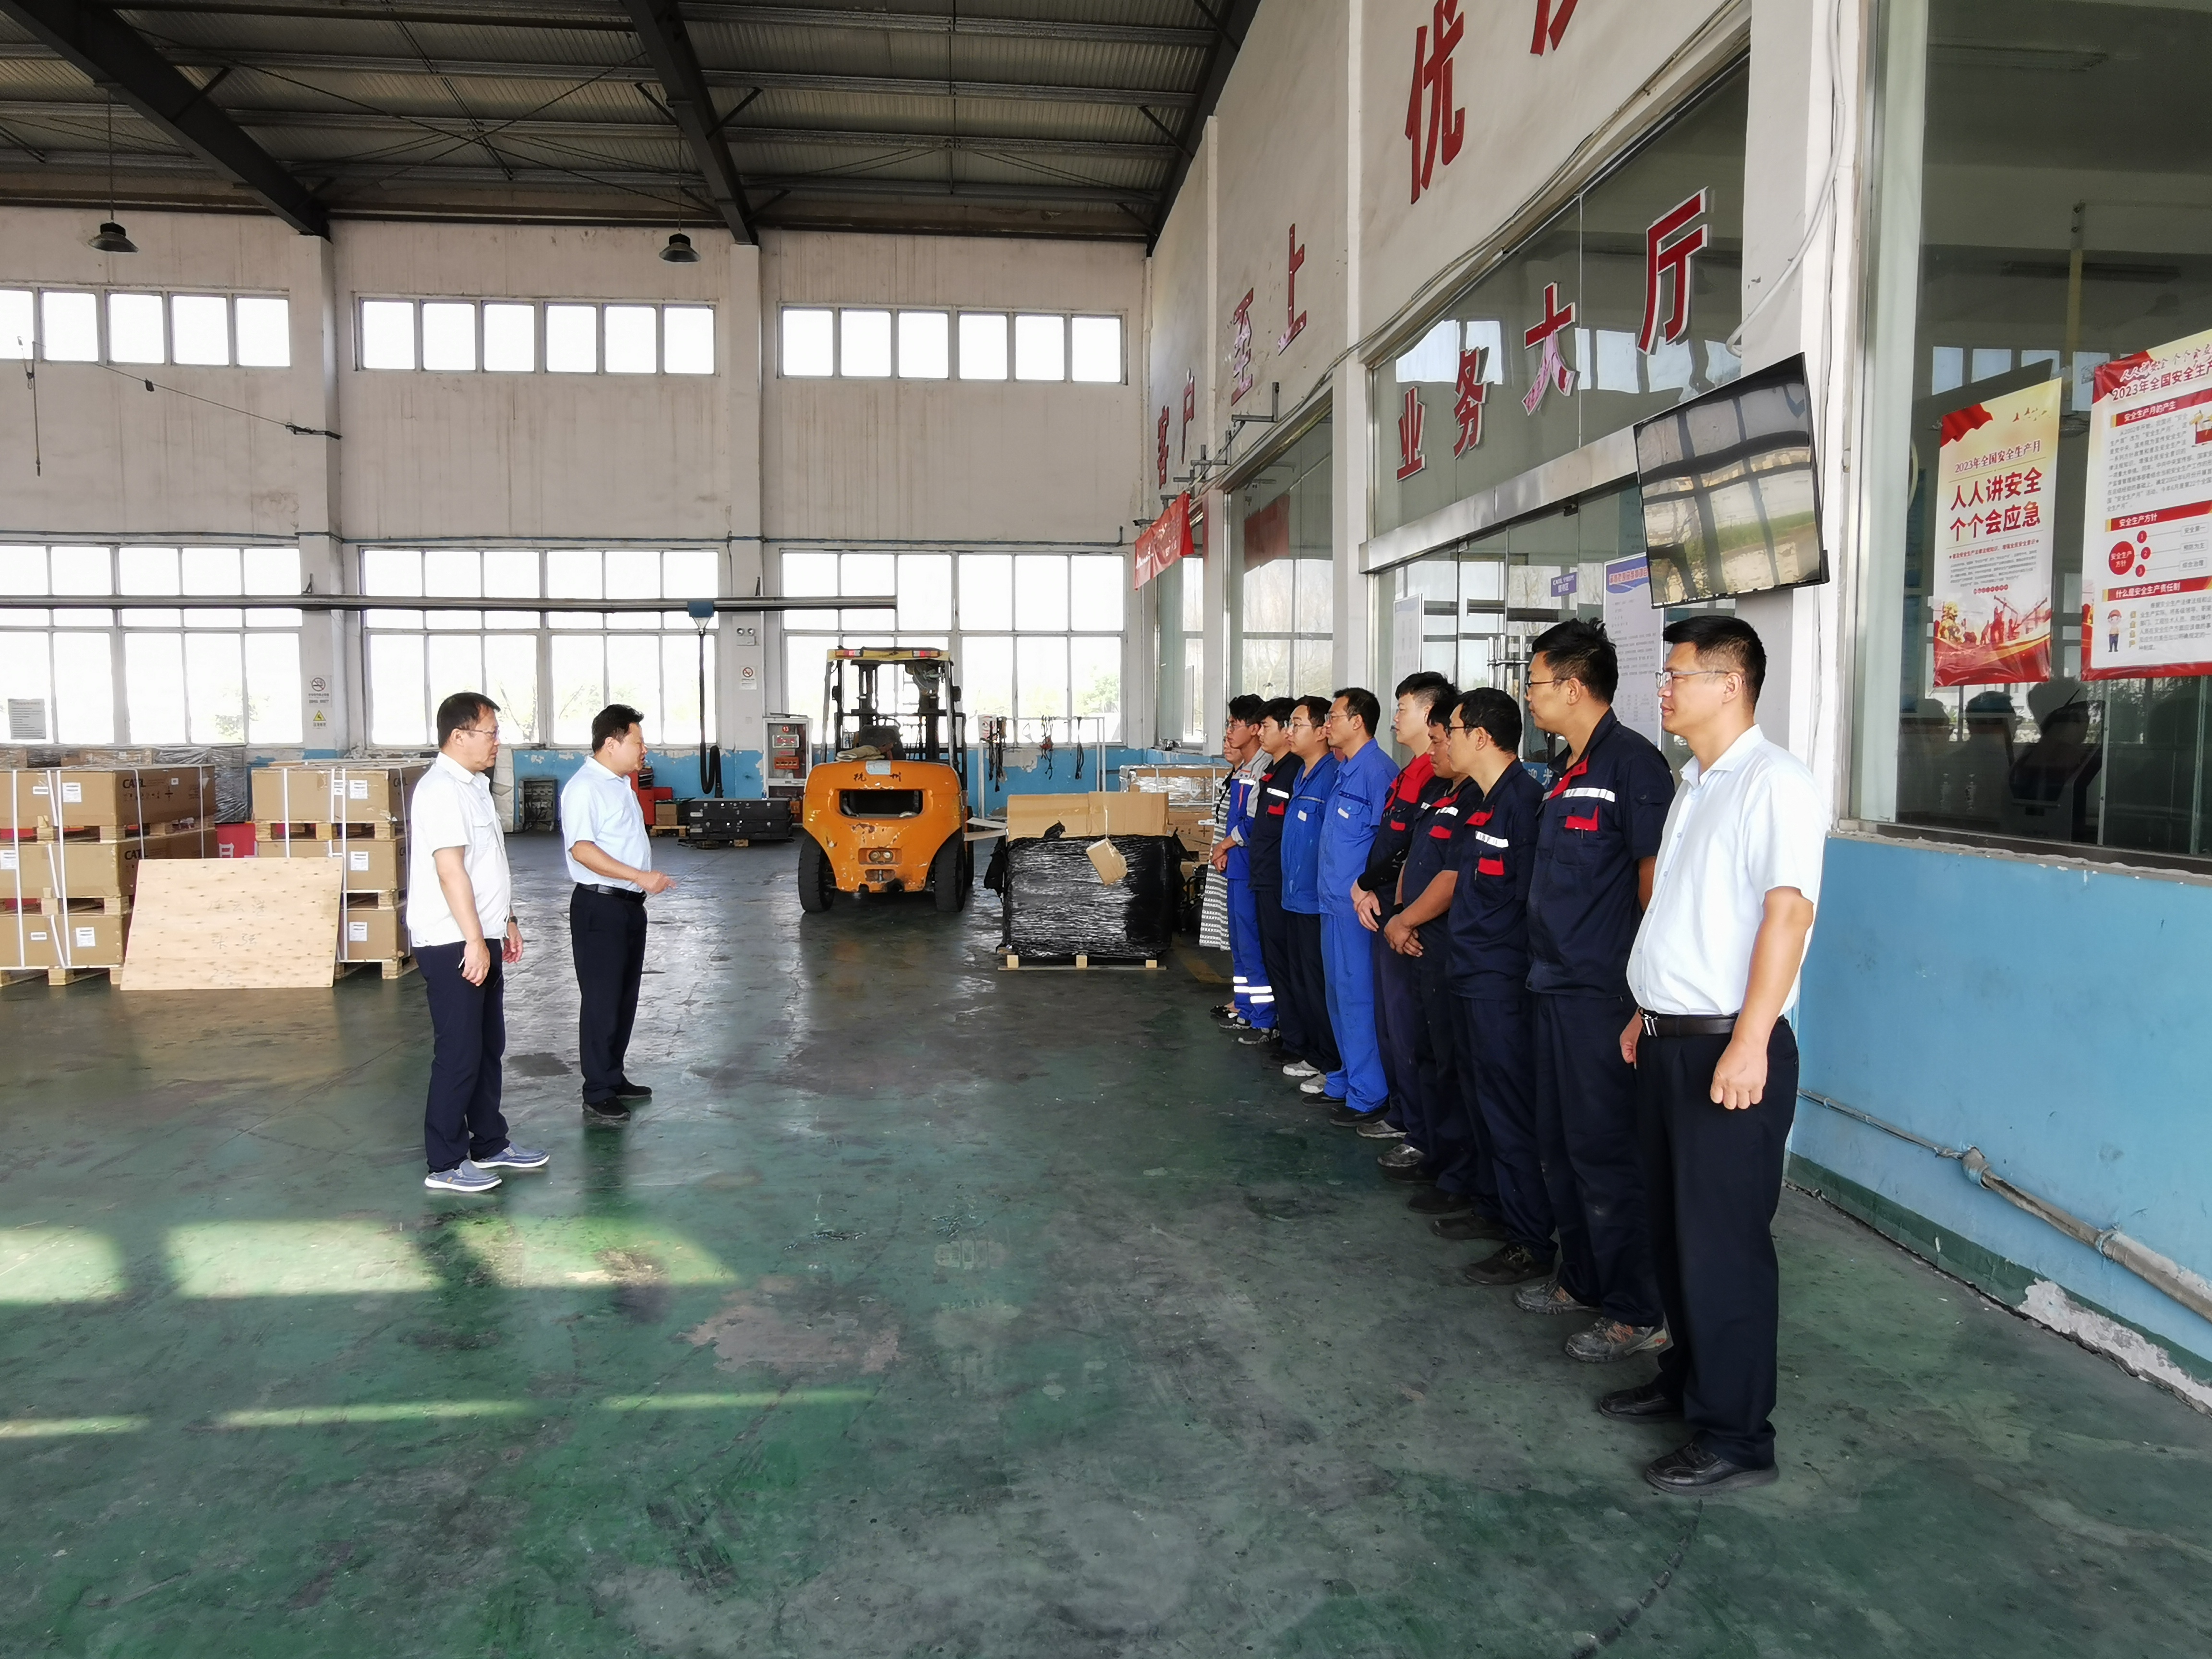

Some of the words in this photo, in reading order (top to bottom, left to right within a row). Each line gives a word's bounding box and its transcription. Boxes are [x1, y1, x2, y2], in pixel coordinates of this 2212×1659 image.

[1397, 186, 1708, 481] 业务大厅
[1157, 224, 1307, 490] 客户至上
[2124, 401, 2176, 422] 安全生产月的产生
[1955, 440, 2041, 473] 2023年全国安全生产月
[1950, 467, 2042, 511] 人人讲安全
[1949, 501, 2041, 542] 个个会应急
[2119, 513, 2158, 528] 安全生产方针
[2111, 551, 2132, 561] 安全生产
[2116, 581, 2181, 598] 什么是安全生产责任制
